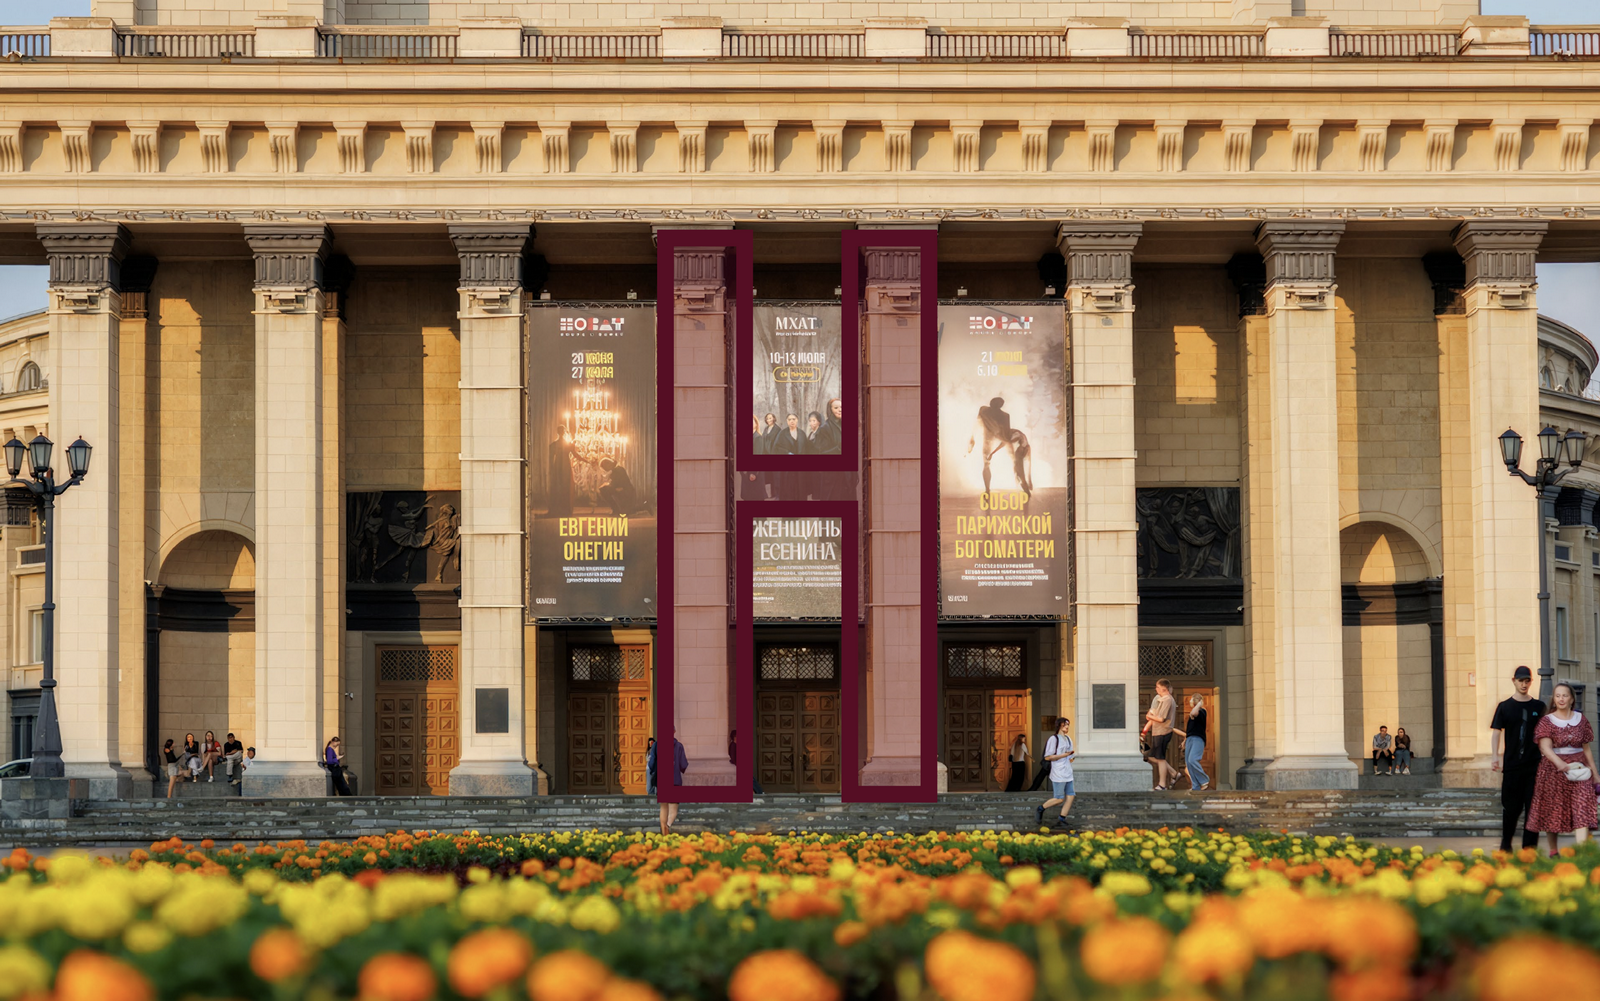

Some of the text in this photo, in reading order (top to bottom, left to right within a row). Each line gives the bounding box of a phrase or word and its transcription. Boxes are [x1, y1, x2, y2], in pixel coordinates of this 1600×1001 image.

[776, 316, 818, 330] МХАТ
[571, 352, 584, 364] 20
[571, 366, 584, 378] 27
[980, 491, 1029, 511] СОБОР
[559, 513, 629, 537] ЕВГЕНИЙ
[957, 512, 1052, 535] ПАРИЖСКОЙ
[563, 541, 624, 561] ОНЕГИН
[760, 542, 837, 561] ЕСЕНИНА
[955, 539, 1055, 558] БОГОМАТЕРИ
